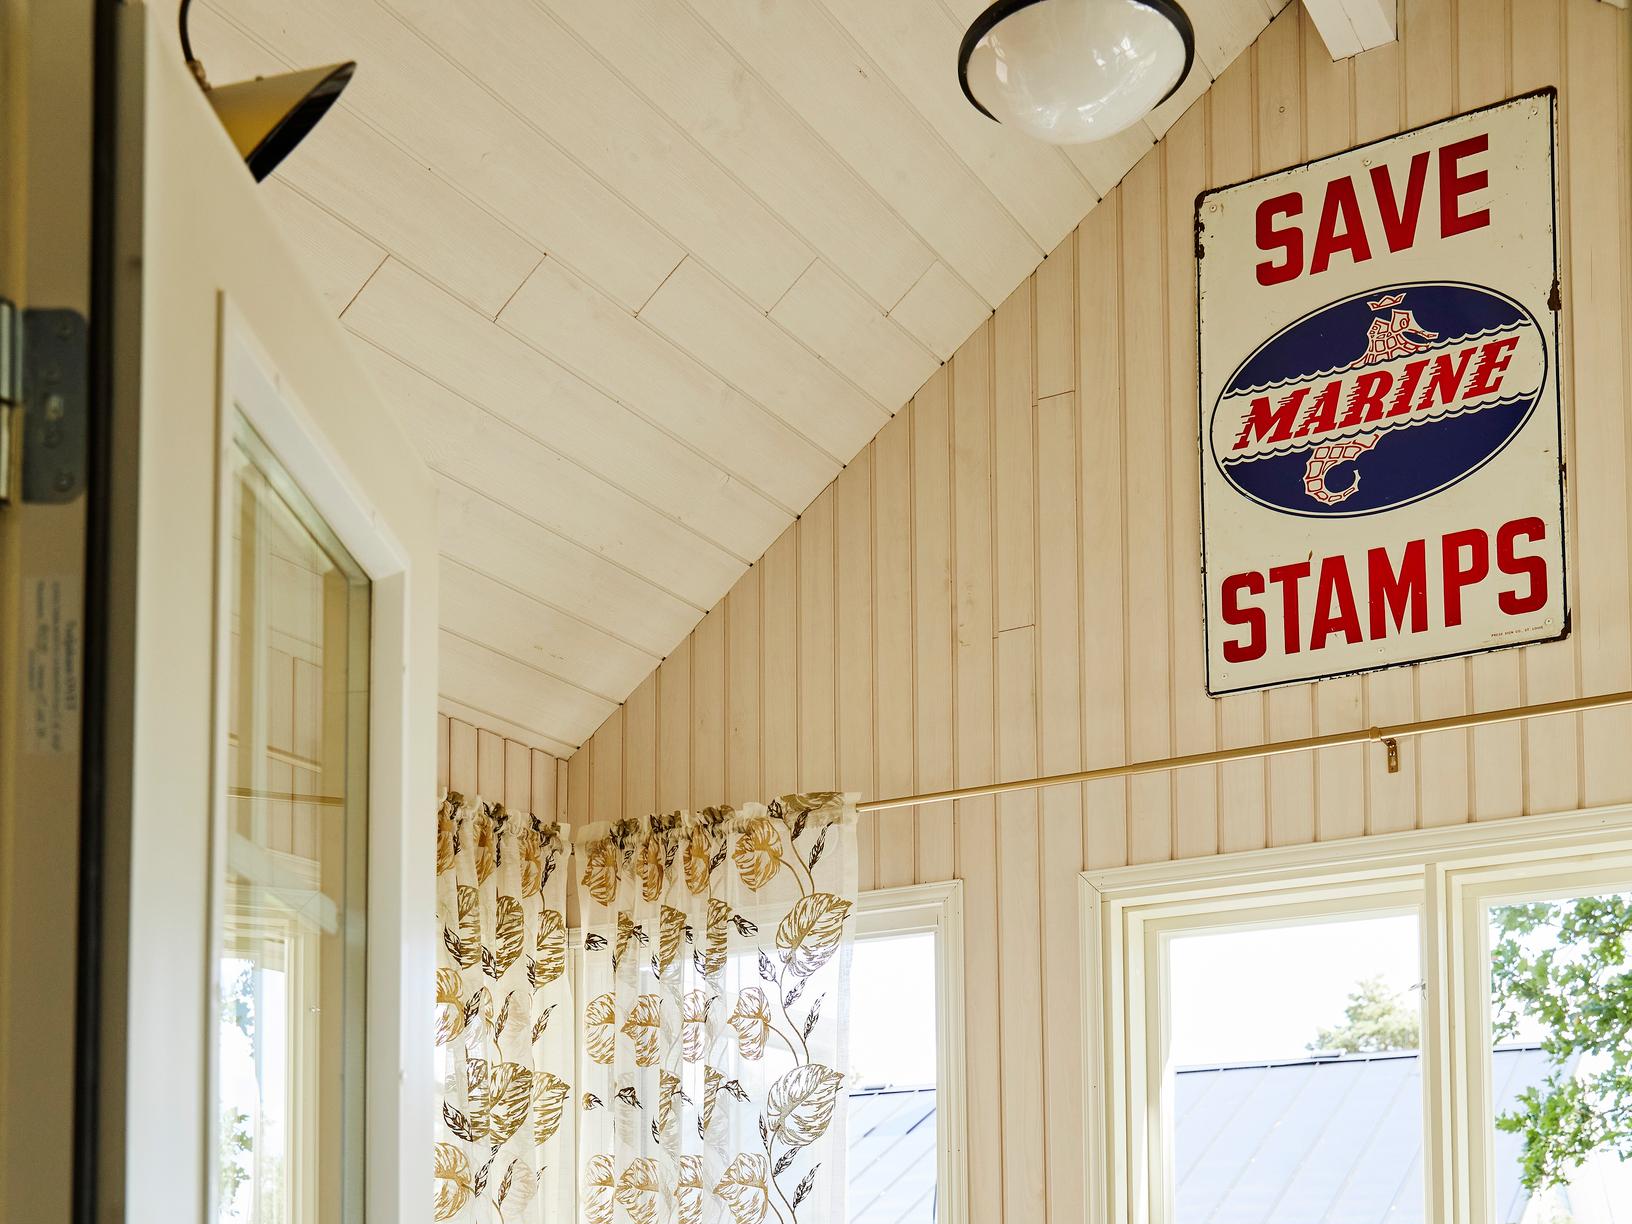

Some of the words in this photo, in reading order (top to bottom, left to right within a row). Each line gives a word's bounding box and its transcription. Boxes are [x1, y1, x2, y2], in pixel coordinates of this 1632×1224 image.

[1255, 133, 1491, 287] SAVE
[1232, 336, 1520, 451] MARINE
[1221, 516, 1548, 664] STAMPS
